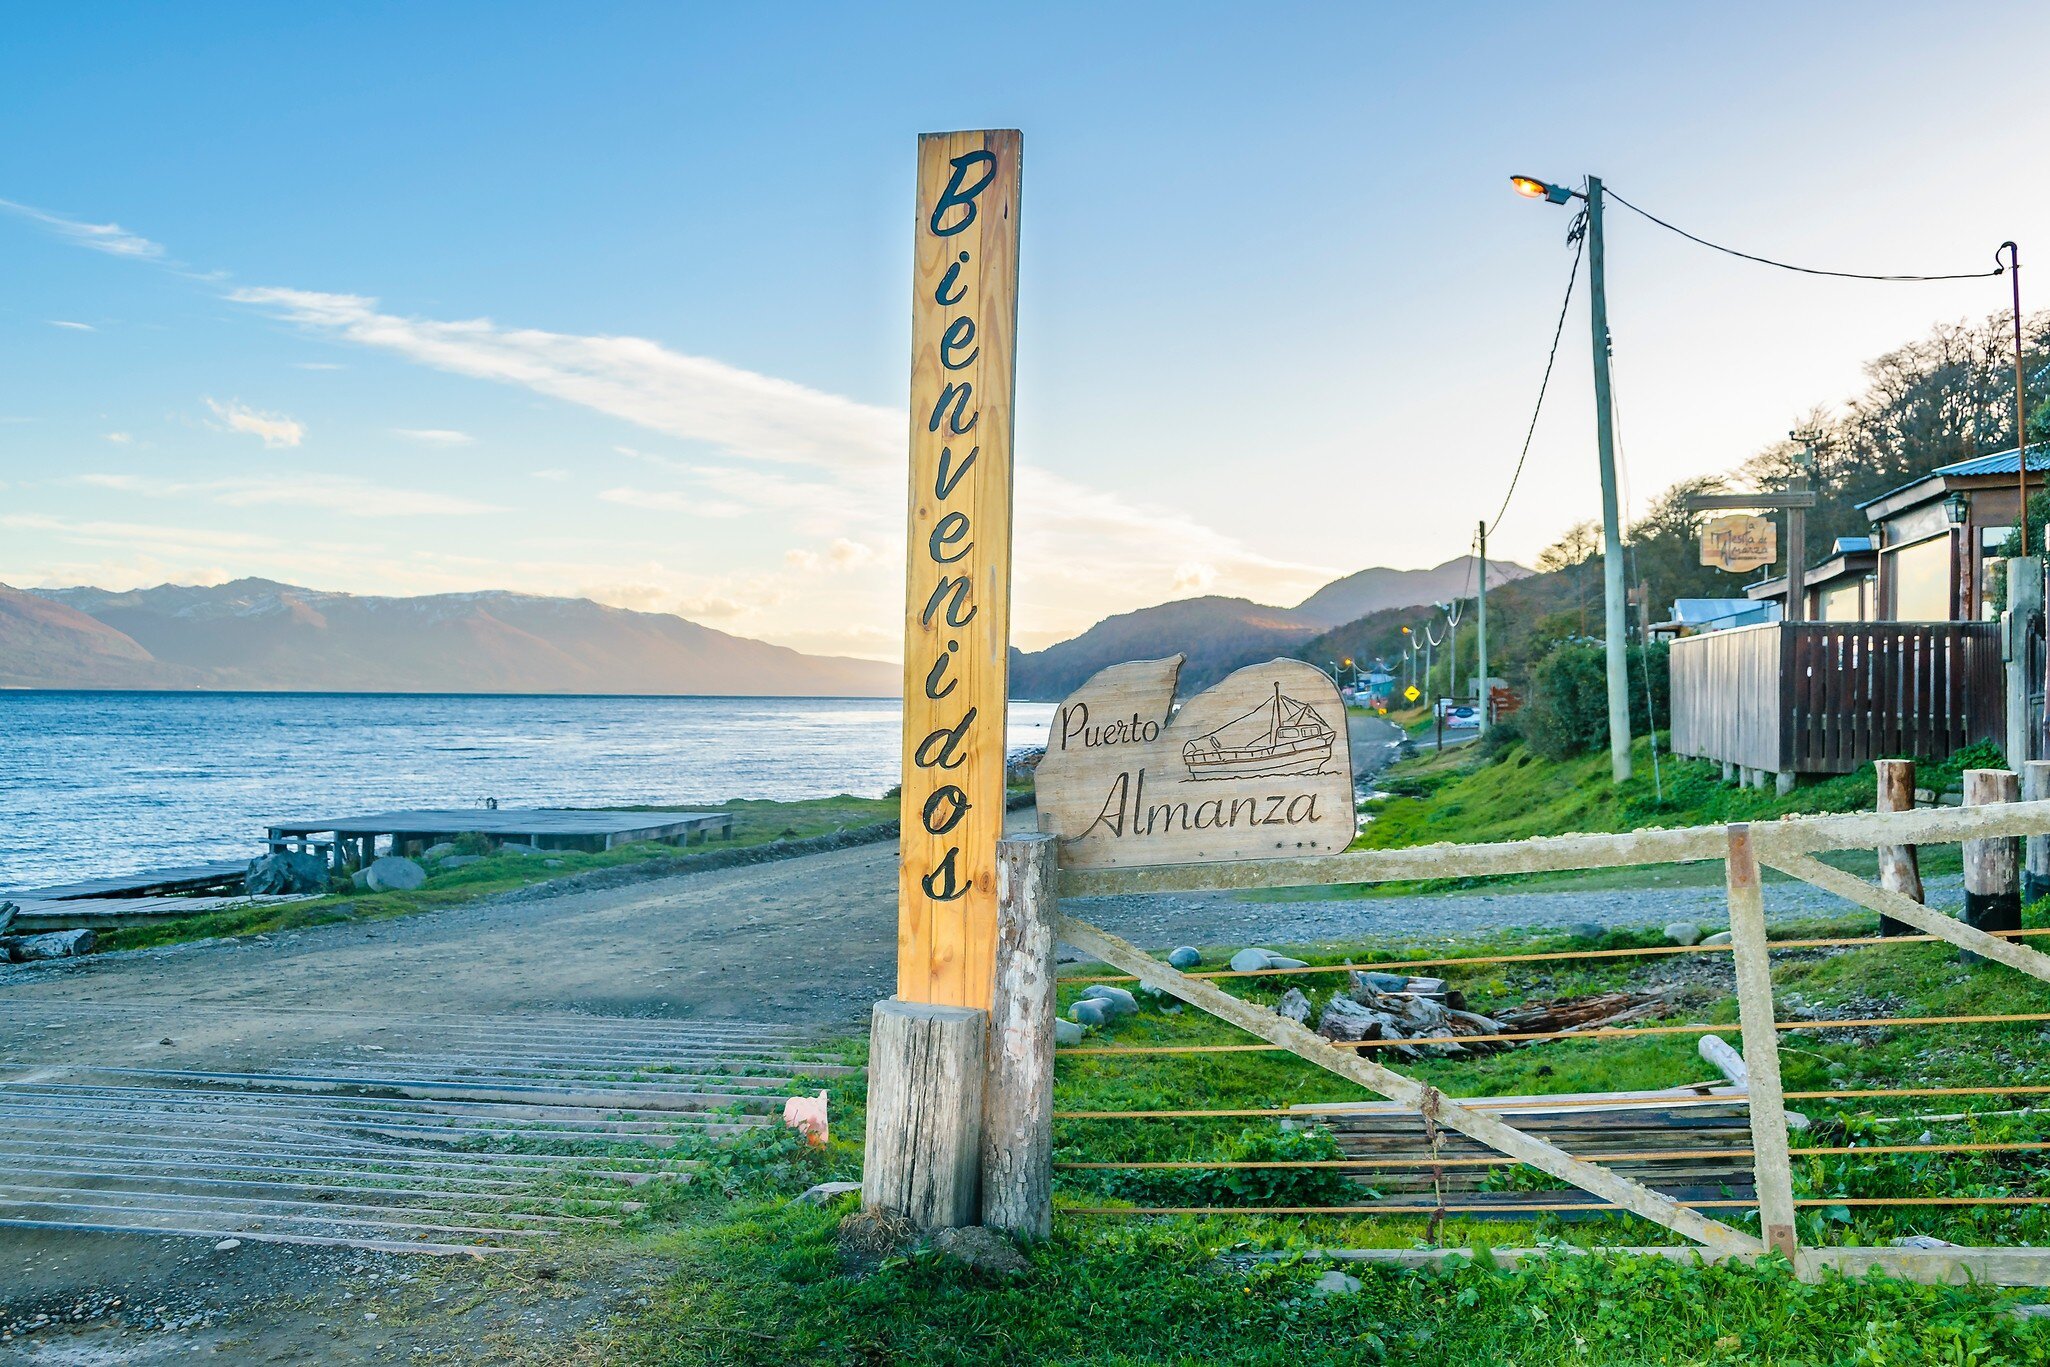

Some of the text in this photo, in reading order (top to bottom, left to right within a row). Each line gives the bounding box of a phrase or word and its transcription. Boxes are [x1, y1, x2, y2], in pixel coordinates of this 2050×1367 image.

[915, 149, 997, 901] Bienvenidos
[1061, 702, 1160, 750] Puerto
[1062, 768, 1322, 844] Almanza
